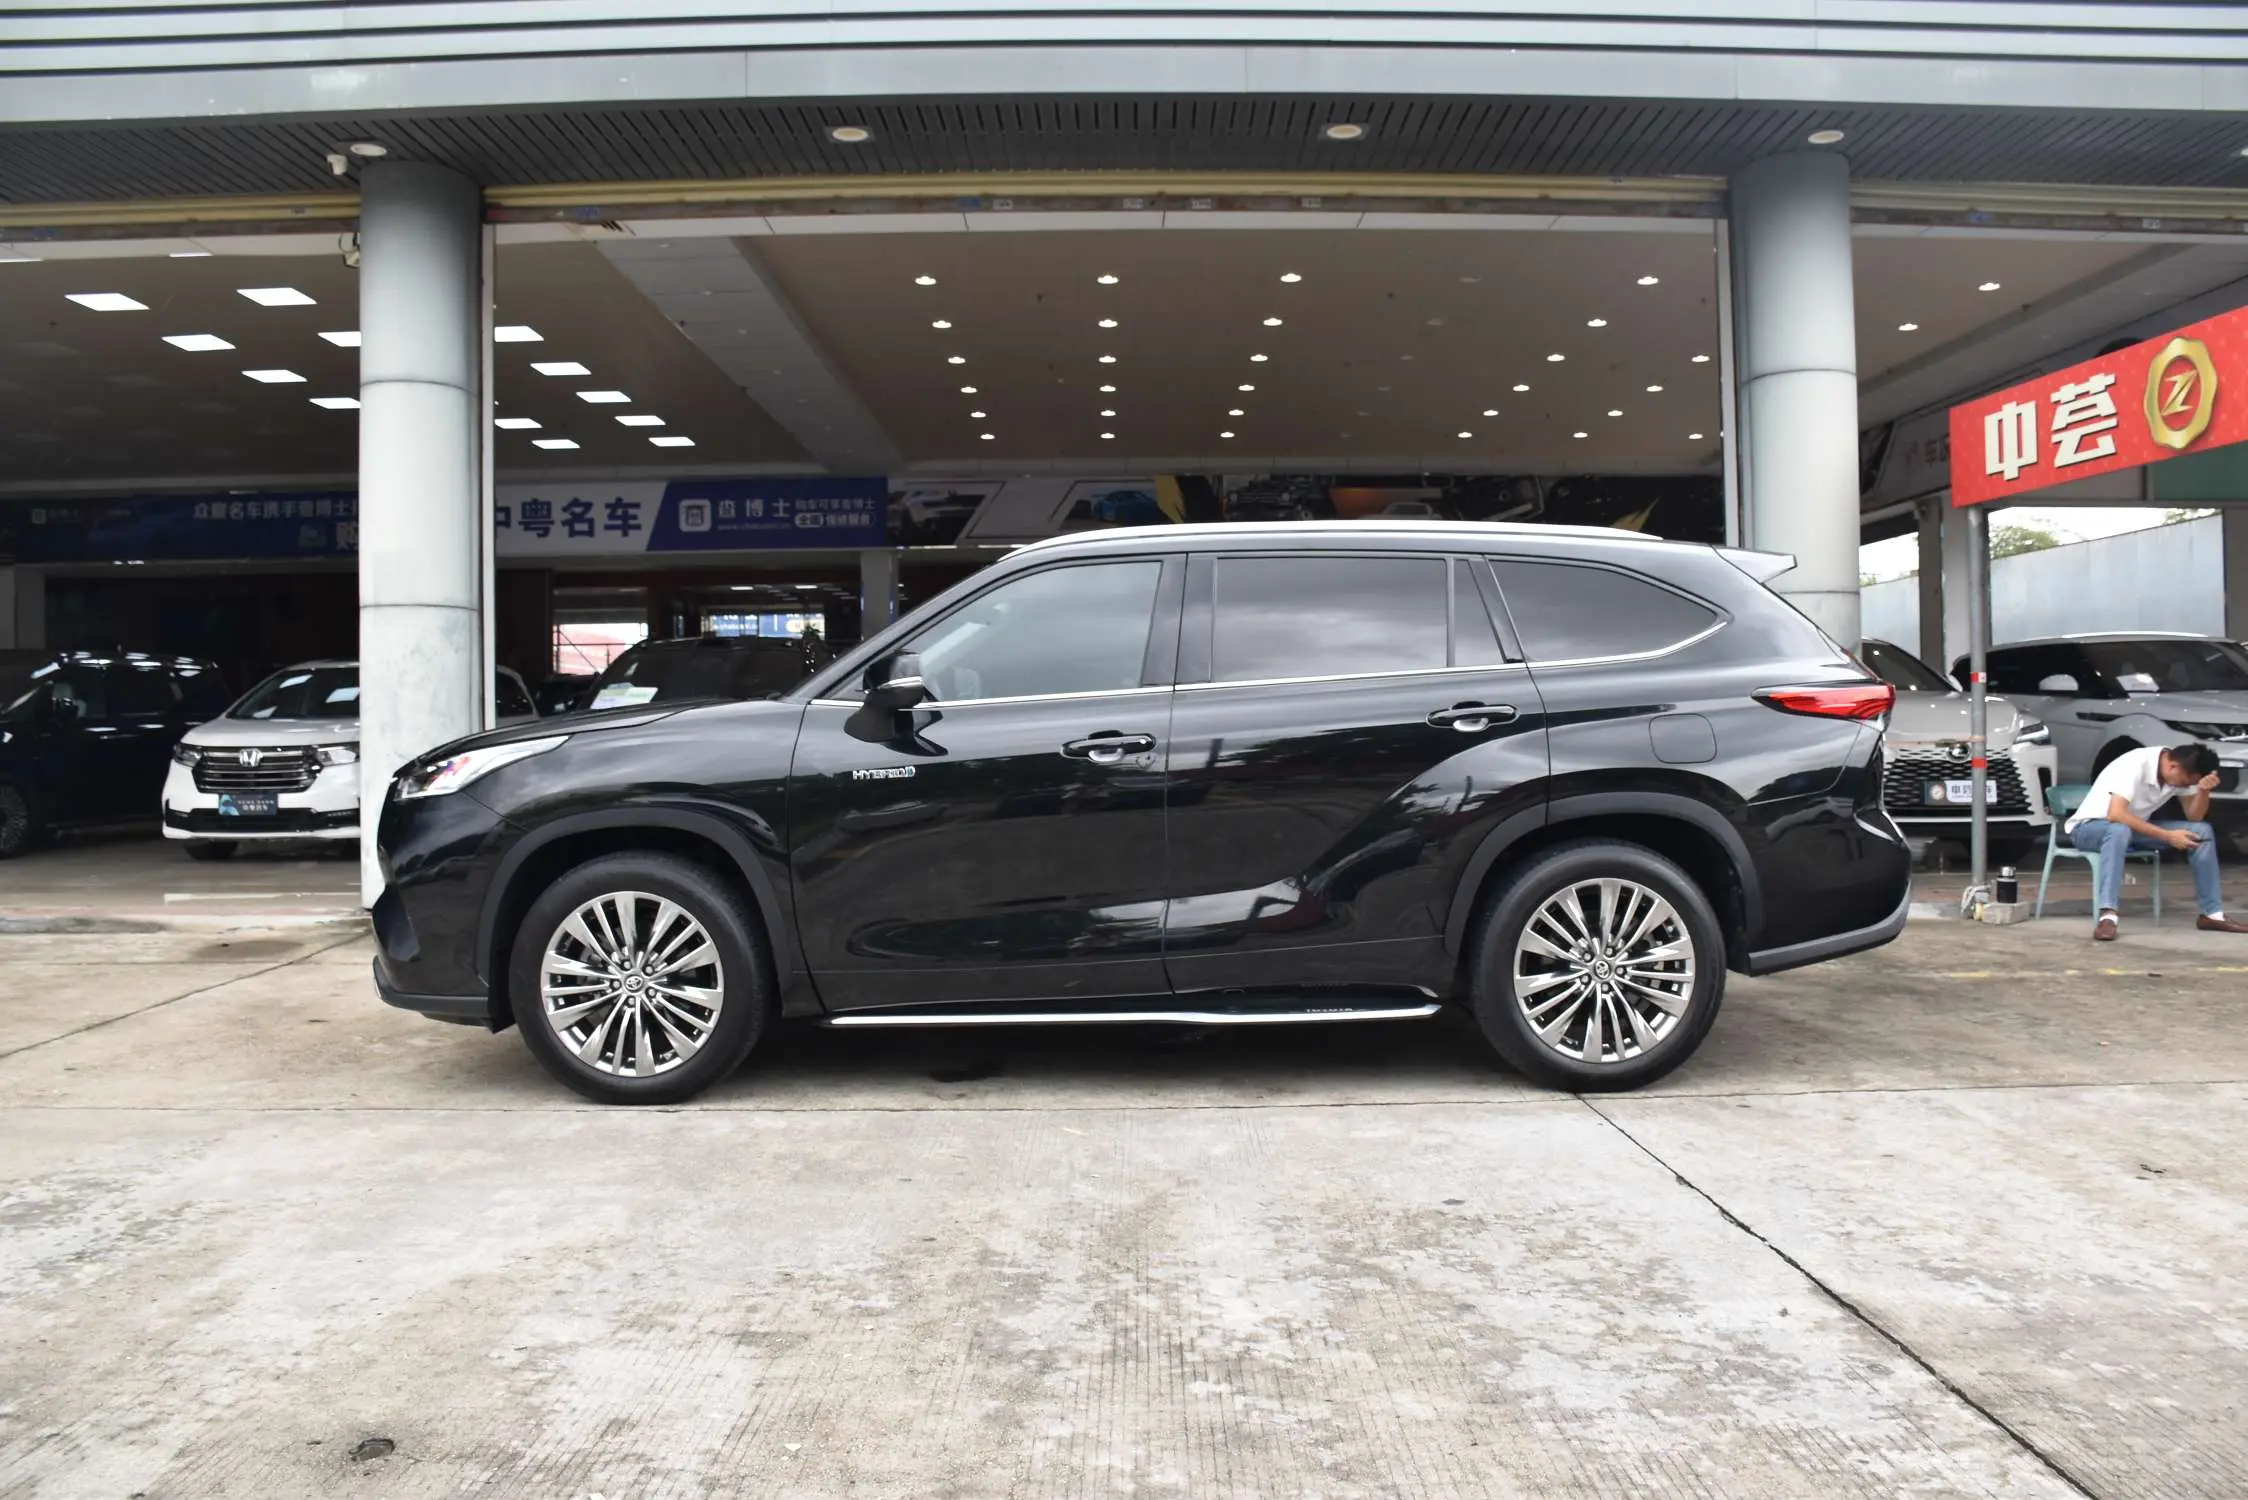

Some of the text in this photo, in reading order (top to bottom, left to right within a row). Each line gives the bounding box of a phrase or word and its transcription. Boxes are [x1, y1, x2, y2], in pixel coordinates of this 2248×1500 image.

[1984, 373, 2118, 481] 中荟
[719, 498, 790, 518] 查博士
